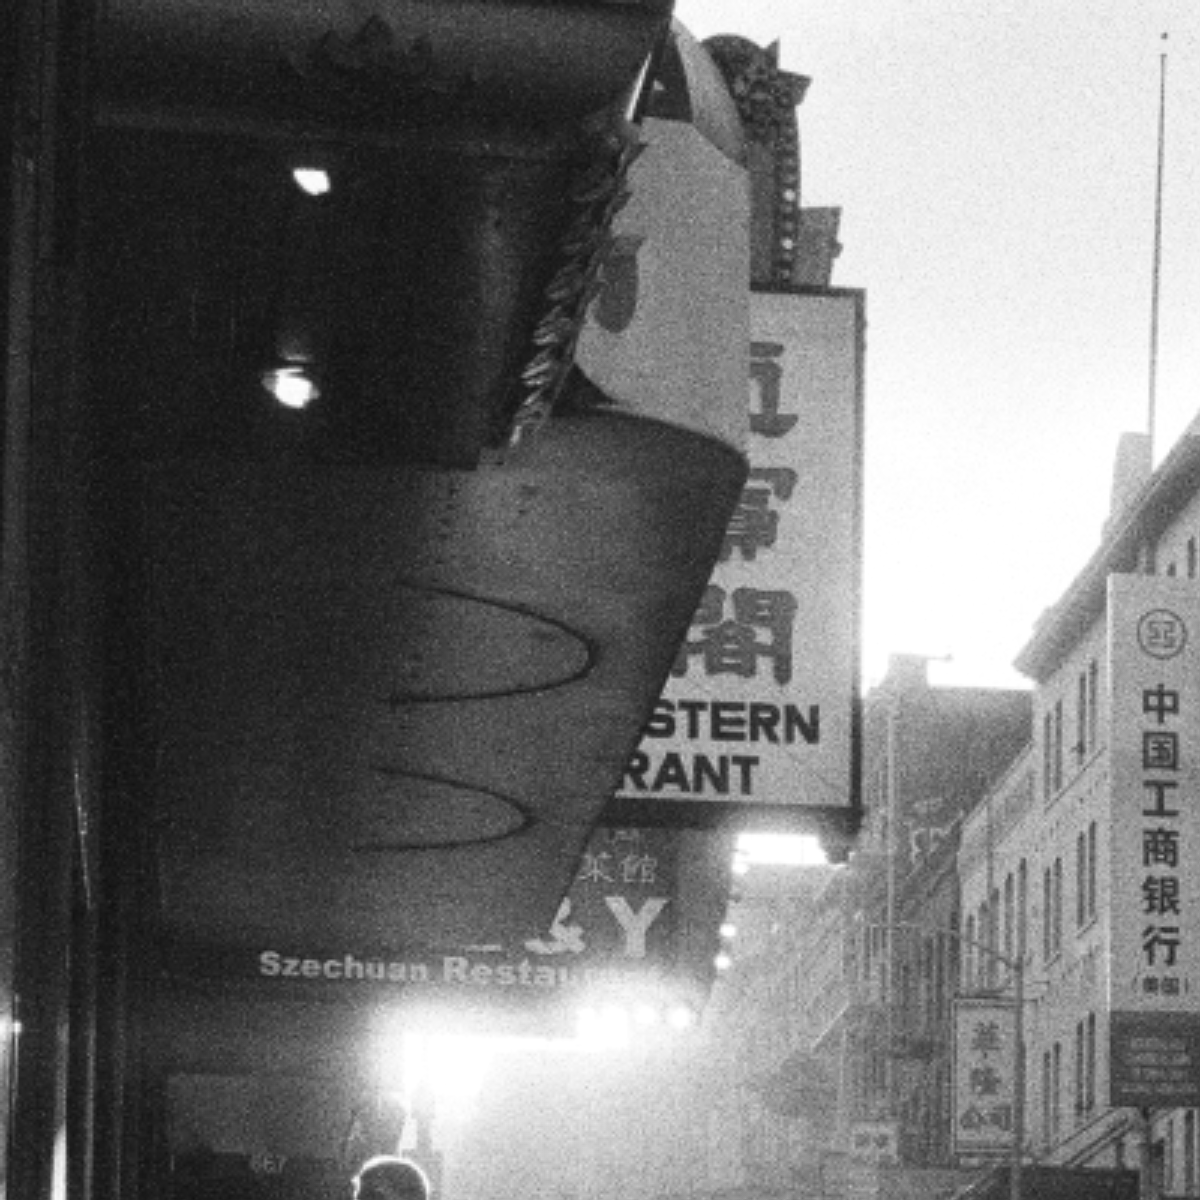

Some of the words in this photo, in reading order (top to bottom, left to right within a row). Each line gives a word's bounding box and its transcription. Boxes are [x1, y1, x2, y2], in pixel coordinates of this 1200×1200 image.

[647, 701, 820, 744] STERN
[623, 753, 760, 795] RANT
[1142, 682, 1181, 967] 中国工商银行
[604, 896, 670, 957] Y
[259, 950, 428, 982] Szechuan
